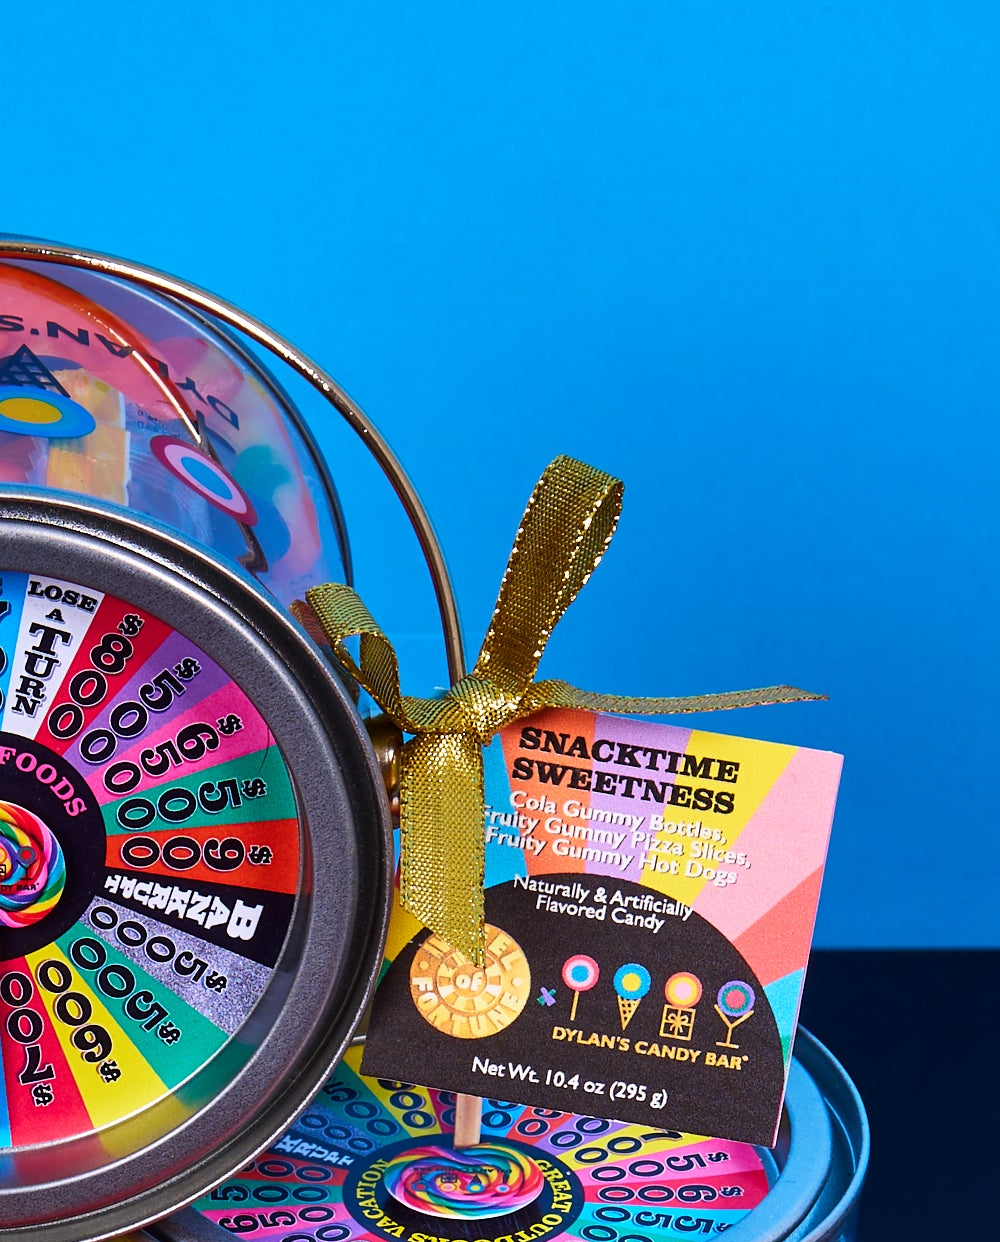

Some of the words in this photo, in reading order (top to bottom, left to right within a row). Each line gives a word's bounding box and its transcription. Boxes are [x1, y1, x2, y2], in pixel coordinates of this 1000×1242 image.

[28, 581, 98, 613] LOSE
[46, 609, 64, 623] A
[12, 622, 72, 717] TURN
[519, 726, 740, 783] SNACKTIME
[512, 757, 735, 815] SWEETNESS
[509, 790, 557, 814] Cola
[563, 800, 645, 832] Gummy
[650, 813, 728, 845] Bottles,
[545, 817, 627, 850] Gummy
[631, 831, 685, 856] Pizza
[691, 841, 752, 868] Slices,
[485, 826, 548, 856] Fruity
[552, 838, 635, 871] Gummy
[639, 852, 680, 875] Hot
[684, 861, 738, 887] Dogs
[104, 875, 264, 941] BANKRUPT
[514, 874, 591, 903] Naturally
[594, 887, 608, 902] &
[610, 889, 695, 921] Artificially
[535, 895, 606, 920] Flavored
[612, 907, 666, 933] Candy
[411, 976, 524, 1037] FORTUNE
[552, 1026, 630, 1052] DYLAN'S
[634, 1041, 702, 1063] CANDY
[472, 1056, 506, 1078] Net
[508, 1062, 541, 1083] Wt.
[544, 1069, 580, 1090] 10.4
[584, 1078, 606, 1095] oz
[609, 1080, 647, 1102] (295
[650, 1088, 669, 1110] g)
[355, 1158, 406, 1239] VACATION
[534, 1158, 574, 1214] GREAT
